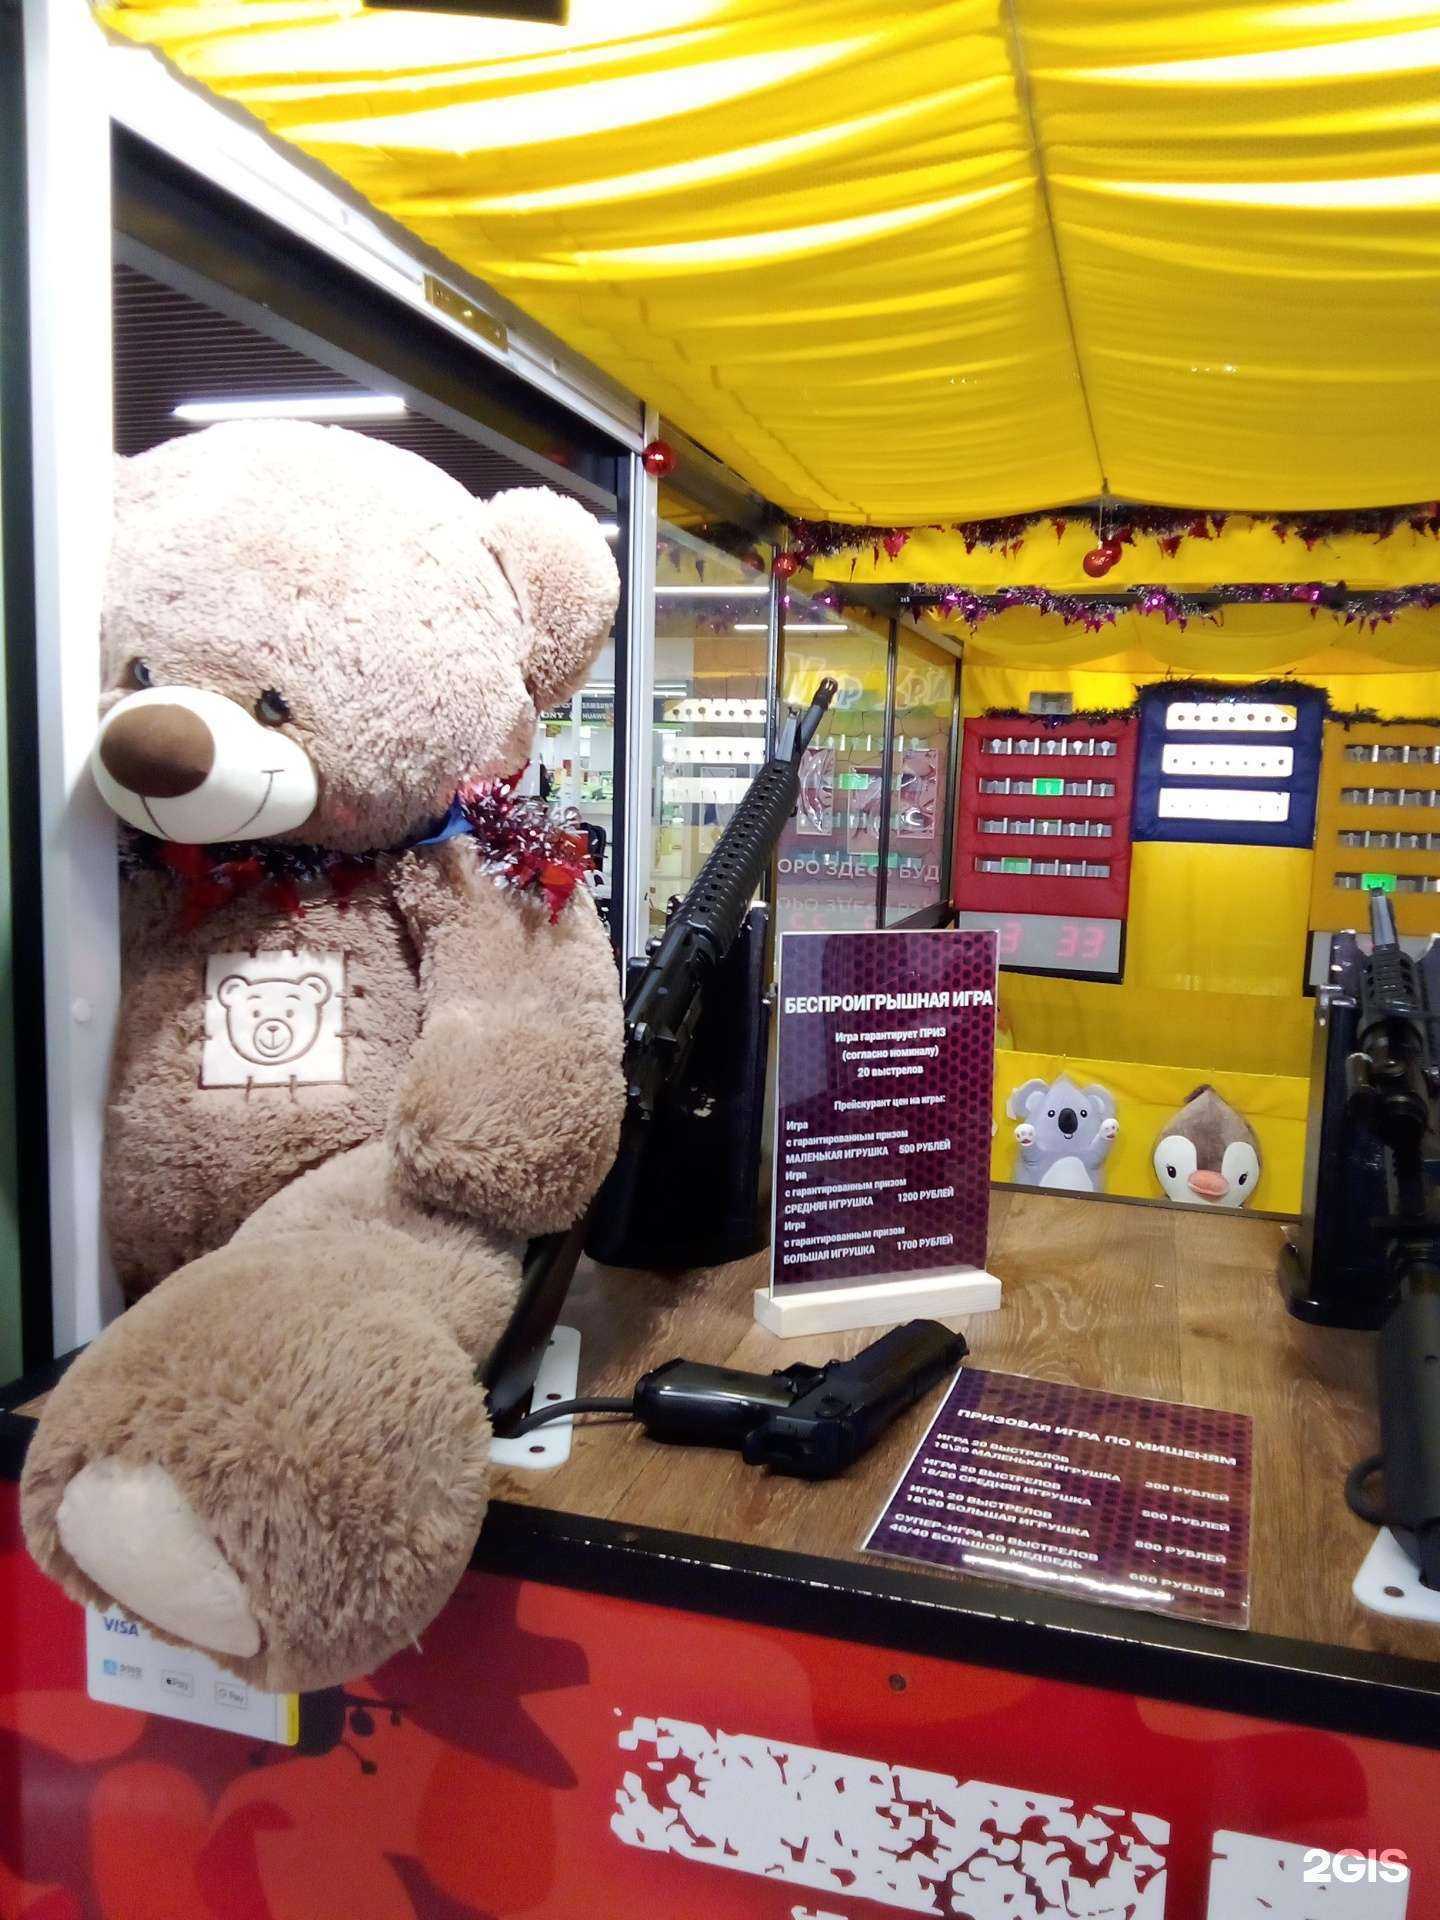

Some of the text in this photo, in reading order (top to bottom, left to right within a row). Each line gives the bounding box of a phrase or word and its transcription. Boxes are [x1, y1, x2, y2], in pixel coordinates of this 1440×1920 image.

[777, 858, 820, 875] ОРО
[899, 864, 940, 883] БУД
[784, 990, 993, 1014] БЕСПРОИГРЫШНАЯ ИГРА
[835, 1028, 946, 1044] Игра гарантирует ПРИЗ
[842, 1045, 940, 1062] (согласно номиналу)
[857, 1065, 924, 1078] 20 выстрелов
[833, 1098, 891, 1111] Прейскурант
[892, 1098, 909, 1108] цен
[909, 1097, 921, 1106] на
[786, 1120, 808, 1132] Игра
[793, 1133, 875, 1148] гарантированным
[876, 1129, 909, 1141] призом
[786, 1138, 951, 1165] МАЛЕНЬКАЯ ИГРУШКА 500 РУБЛЕЙ
[785, 1171, 807, 1182] Игра
[792, 1182, 873, 1198] гарантированным
[874, 1178, 907, 1190] призом
[785, 1186, 954, 1215] СРЕДНЯЯ ИГРУШКА 1200 РУБЛЕЙ
[784, 1221, 806, 1232] Игра
[784, 1226, 906, 1248] с гарантированным призом
[784, 1233, 954, 1265] БОЛЬШАЯ ИГРУШКА 1700 РУБЛЕЙ
[937, 1433, 1070, 1463] ИГРА 20 ВЫСТРЕЛОВ
[957, 1408, 1237, 1466] ПРИЗОВАЯ ИГРА ПО МИШЕНЯМ
[924, 1458, 1061, 1490] ИГРА 20 ВЫСТРЕЛОВ
[971, 1448, 1053, 1469] МАЛЕНЬКАЯ
[1054, 1463, 1121, 1482] ИГРУШКА
[1172, 1485, 1230, 1502] РУБЛЕЙ
[910, 1484, 1053, 1519] ИГРА 20 ВЫСТРЕЛОВ
[958, 1474, 1021, 1493] СРЕДНЯЯ
[1022, 1486, 1092, 1506] ИГРУШКА
[1171, 1515, 1230, 1532] РУБЛЕЙ
[895, 1513, 1099, 1562] СУПЕР-ИГРА 40 ВЫСТРЕЛОВ
[946, 1503, 1017, 1524] БОЛЬШАЯ
[1019, 1516, 1090, 1538] ИГРУШКА
[1165, 1546, 1227, 1564] РУБЛЕЙ
[889, 1524, 929, 1538] 40/40
[931, 1532, 1007, 1555] БОЛЬШОЙ
[1008, 1549, 1083, 1570] МЕДВЕДЬ
[1161, 1578, 1225, 1598] РУБЛЕЙ
[103, 1616, 139, 1637] VISA
